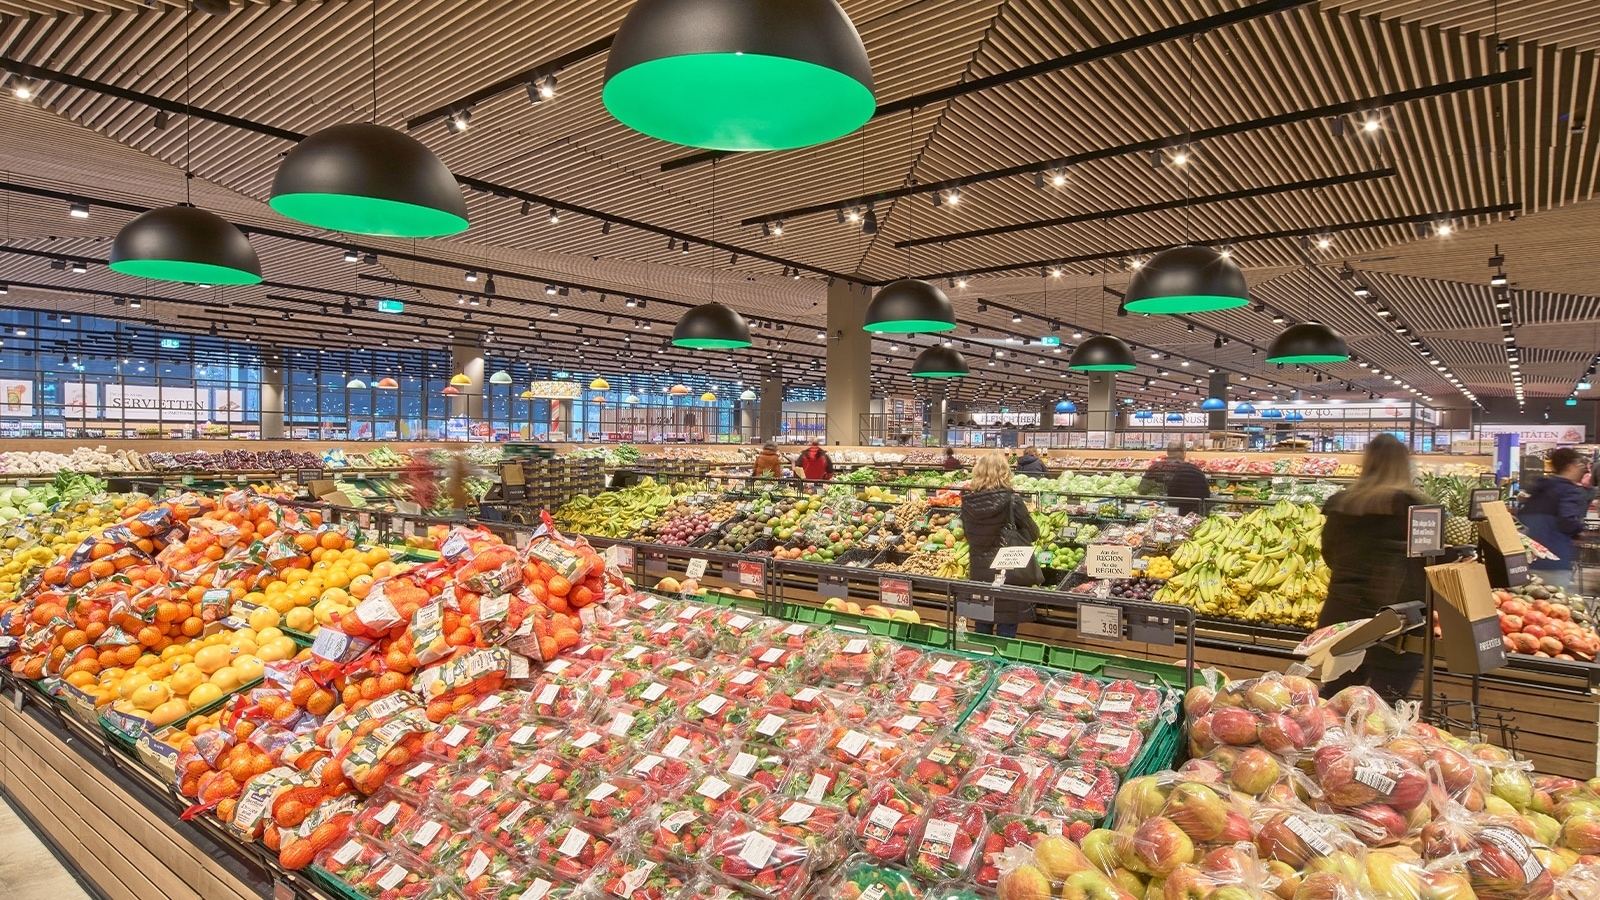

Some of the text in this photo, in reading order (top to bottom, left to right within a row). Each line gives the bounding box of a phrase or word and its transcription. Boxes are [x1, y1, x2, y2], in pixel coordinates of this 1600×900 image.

[112, 397, 204, 410] SERVIETTEN
[1316, 408, 1334, 416] CO.
[1095, 567, 1125, 575] REGION.
[1102, 622, 1118, 635] 3.99
